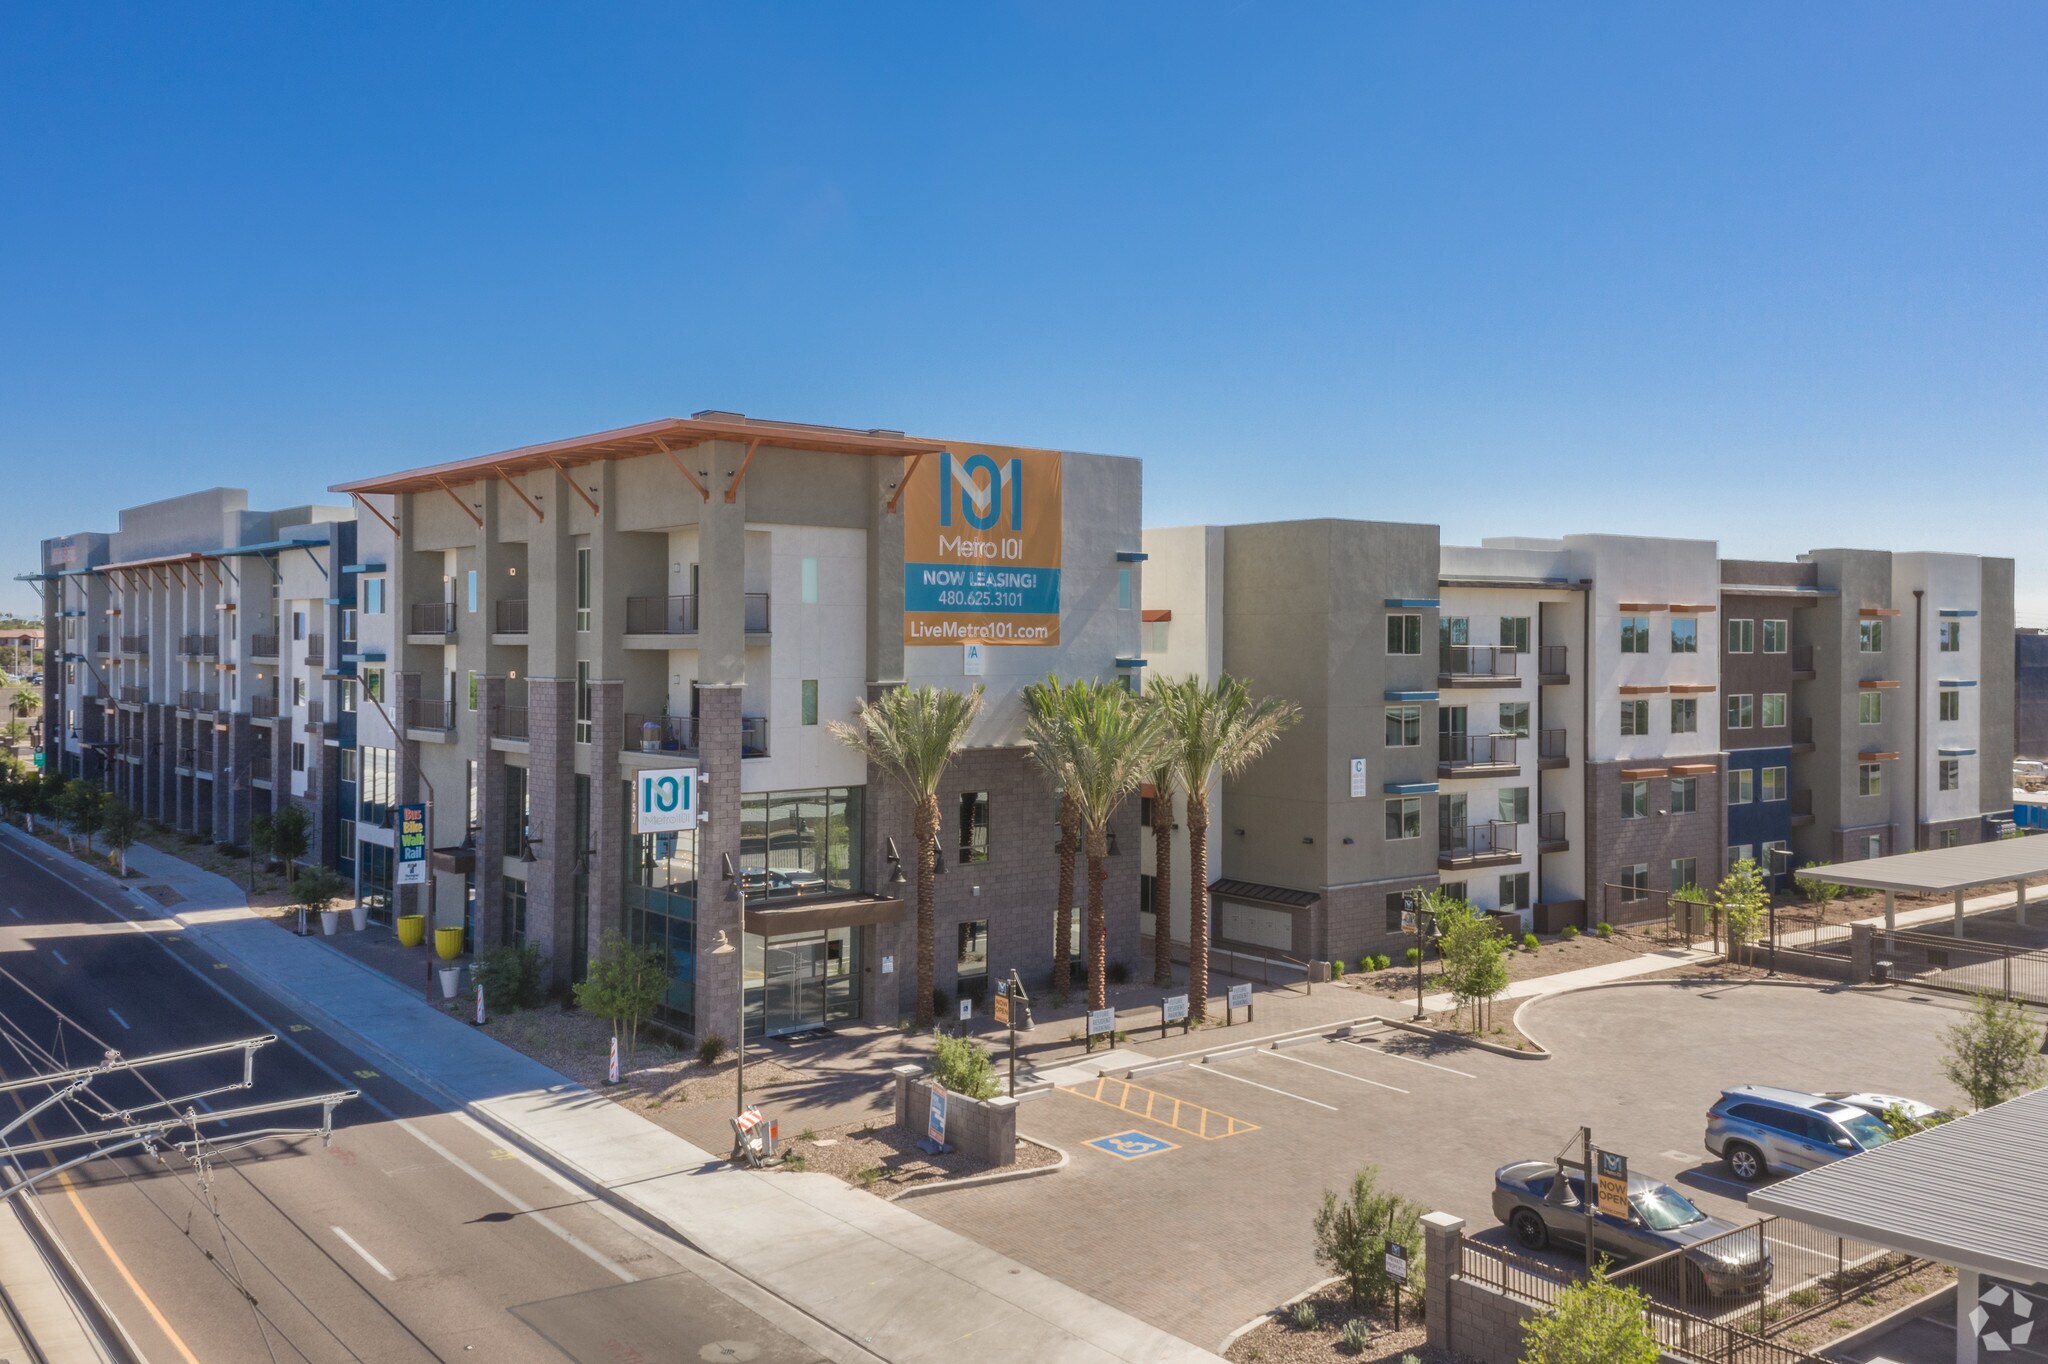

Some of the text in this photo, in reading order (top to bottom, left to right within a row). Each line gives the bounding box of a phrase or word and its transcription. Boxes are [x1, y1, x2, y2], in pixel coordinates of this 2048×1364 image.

[939, 535, 1023, 560] Metro 101
[923, 570, 1037, 588] NOW LEASING!
[938, 590, 1023, 607] 480.625.3101
[911, 621, 1048, 639] LiveMetro101.com
[403, 808, 422, 821] Bus
[643, 815, 676, 825] Metro
[402, 820, 424, 834] Bike
[401, 833, 425, 847] Walk
[404, 846, 422, 860] Rail
[1231, 991, 1250, 1001] RESIDENT
[1167, 1003, 1185, 1012] RESIDENT
[1231, 999, 1249, 1008] PARKING
[1092, 1016, 1112, 1026] RESIDENT
[1167, 1010, 1185, 1019] PARKING
[1092, 1023, 1112, 1033] PARKING
[1599, 1179, 1626, 1195] NOW
[1599, 1190, 1627, 1206] OPEN
